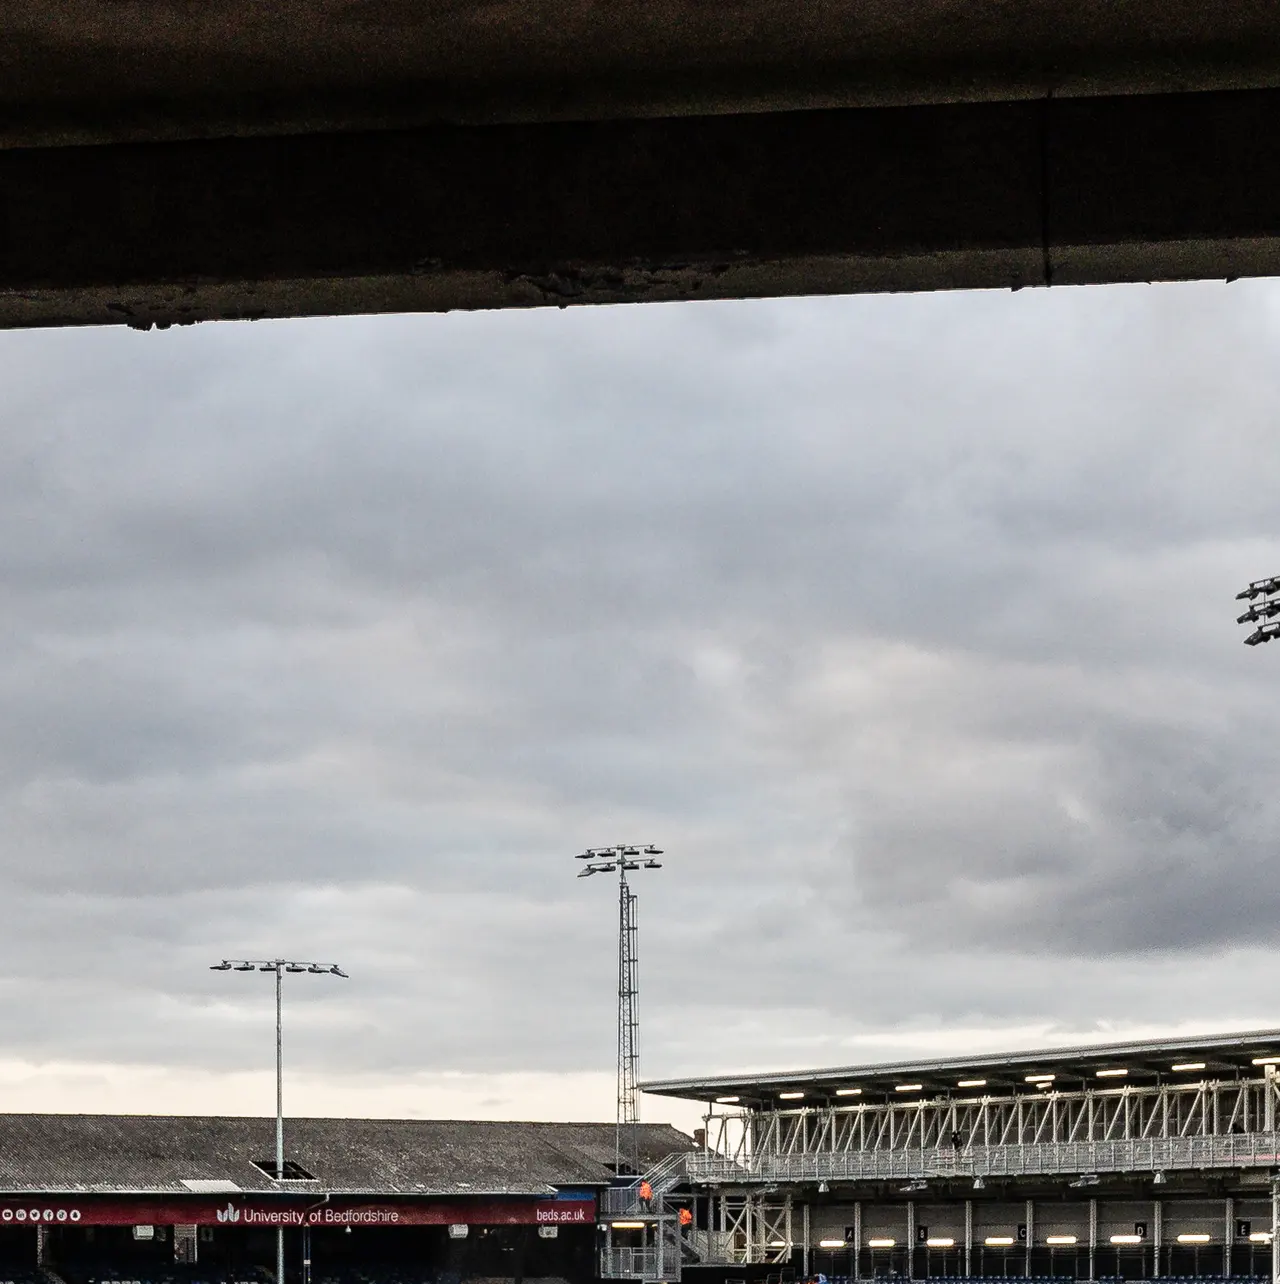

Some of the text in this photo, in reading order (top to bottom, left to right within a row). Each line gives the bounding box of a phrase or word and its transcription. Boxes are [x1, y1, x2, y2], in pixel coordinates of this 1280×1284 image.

[244, 1208, 399, 1224] University of Bedfordshire
[536, 1208, 586, 1222] beds.ac.uk
